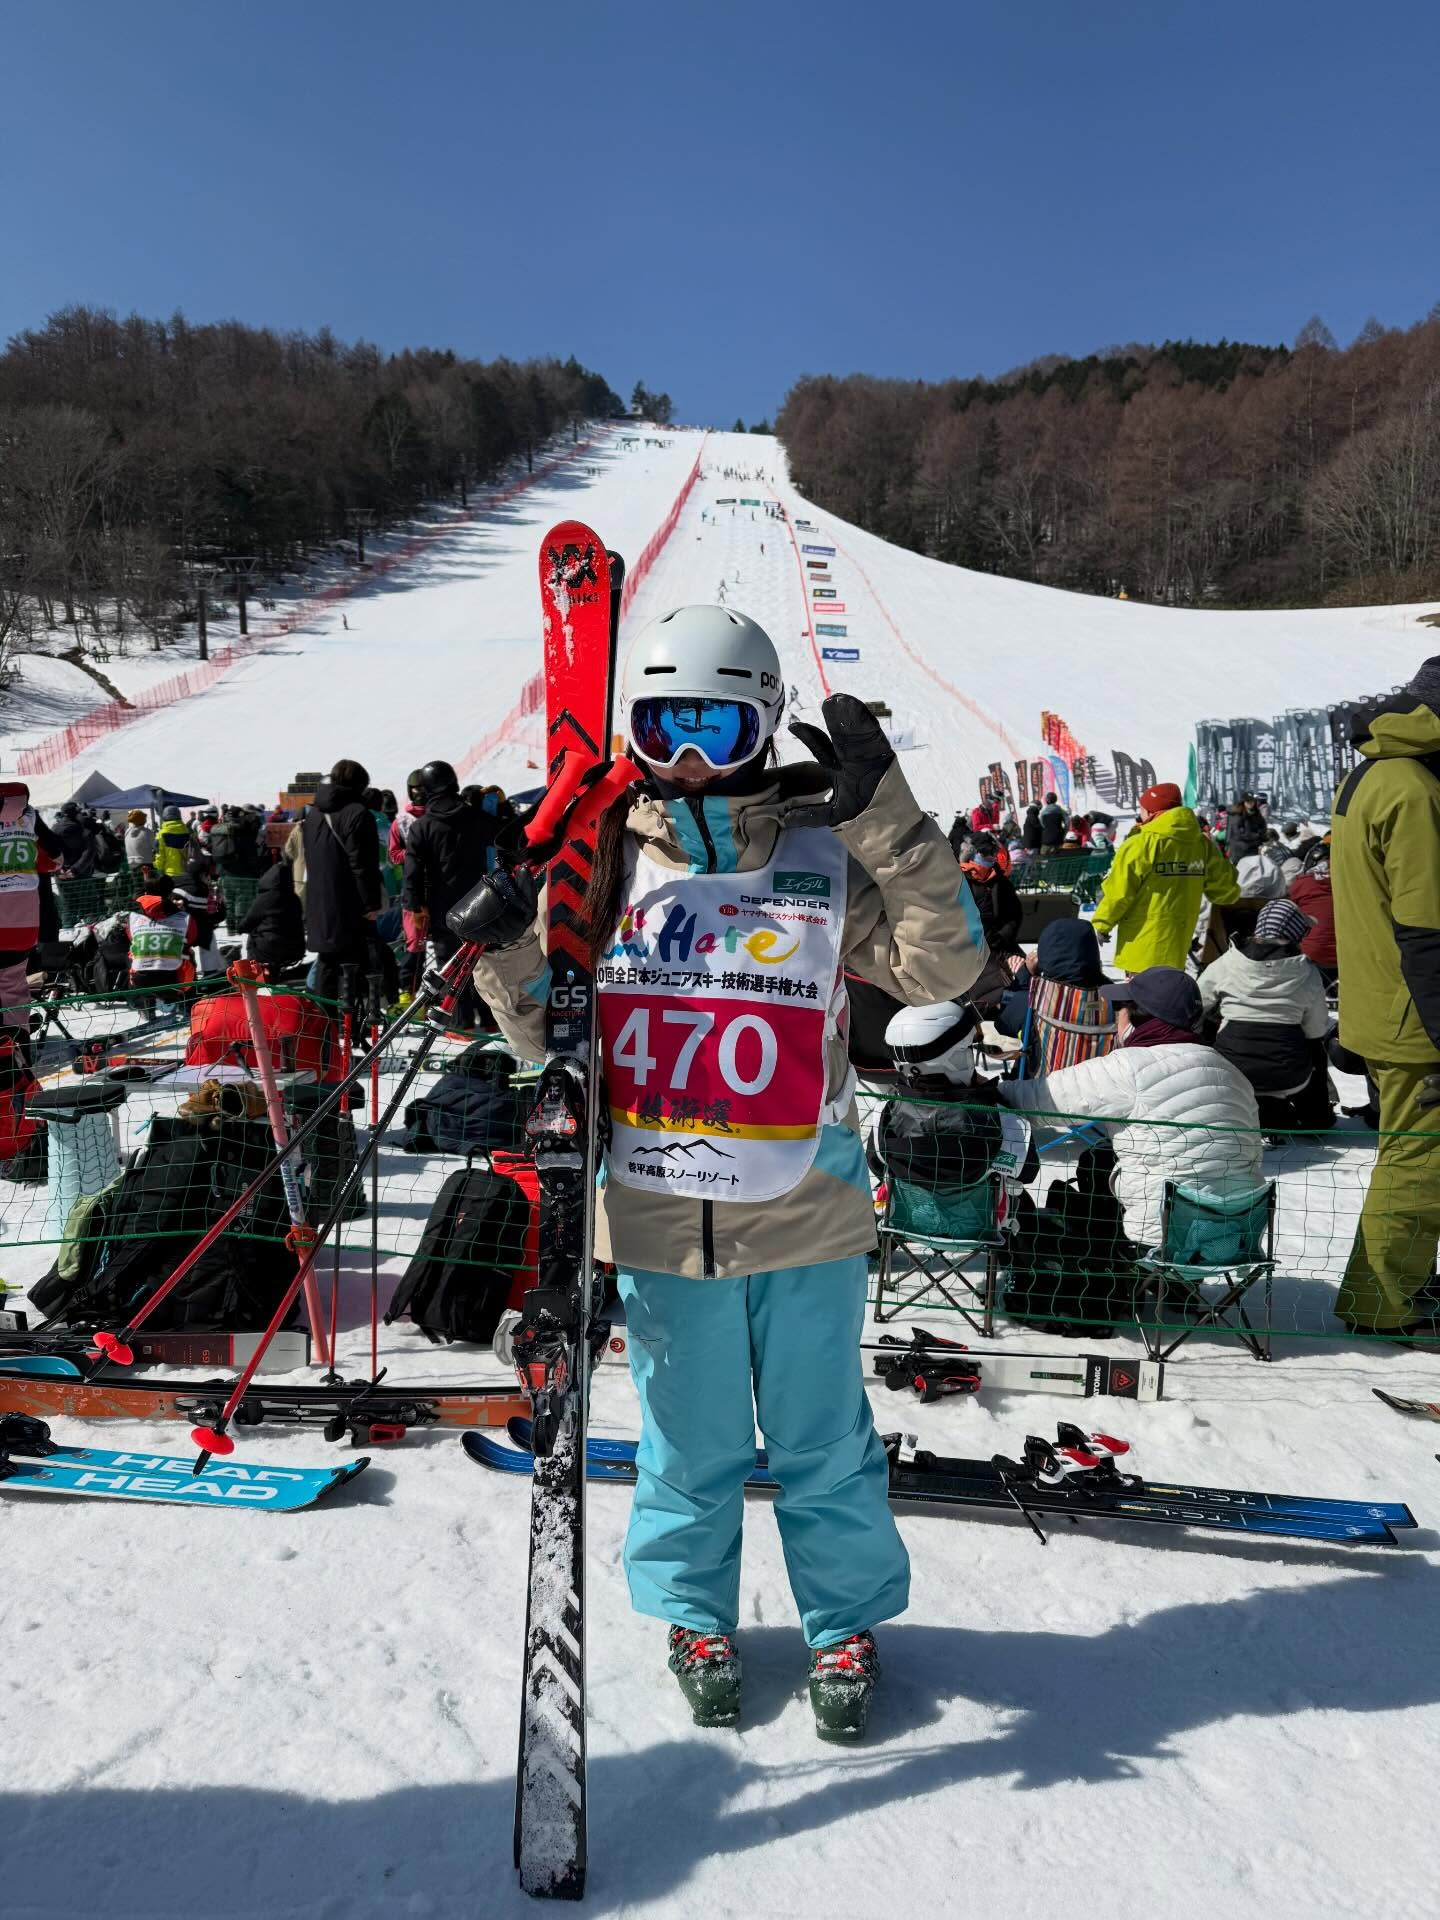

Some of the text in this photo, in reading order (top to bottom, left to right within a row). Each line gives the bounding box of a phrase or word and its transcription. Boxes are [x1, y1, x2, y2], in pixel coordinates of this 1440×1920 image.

[781, 877, 826, 891] エイブル
[740, 894, 830, 910] DEFENDER
[741, 908, 828, 926] ヤマザキビスケット株式会社
[137, 934, 174, 951] 137
[551, 985, 588, 1008] GS
[612, 1007, 778, 1096] 470
[639, 1091, 734, 1134] 技術選
[628, 1161, 740, 1186] 菅平高原スノーリゾート
[74, 1472, 279, 1500] HEAD
